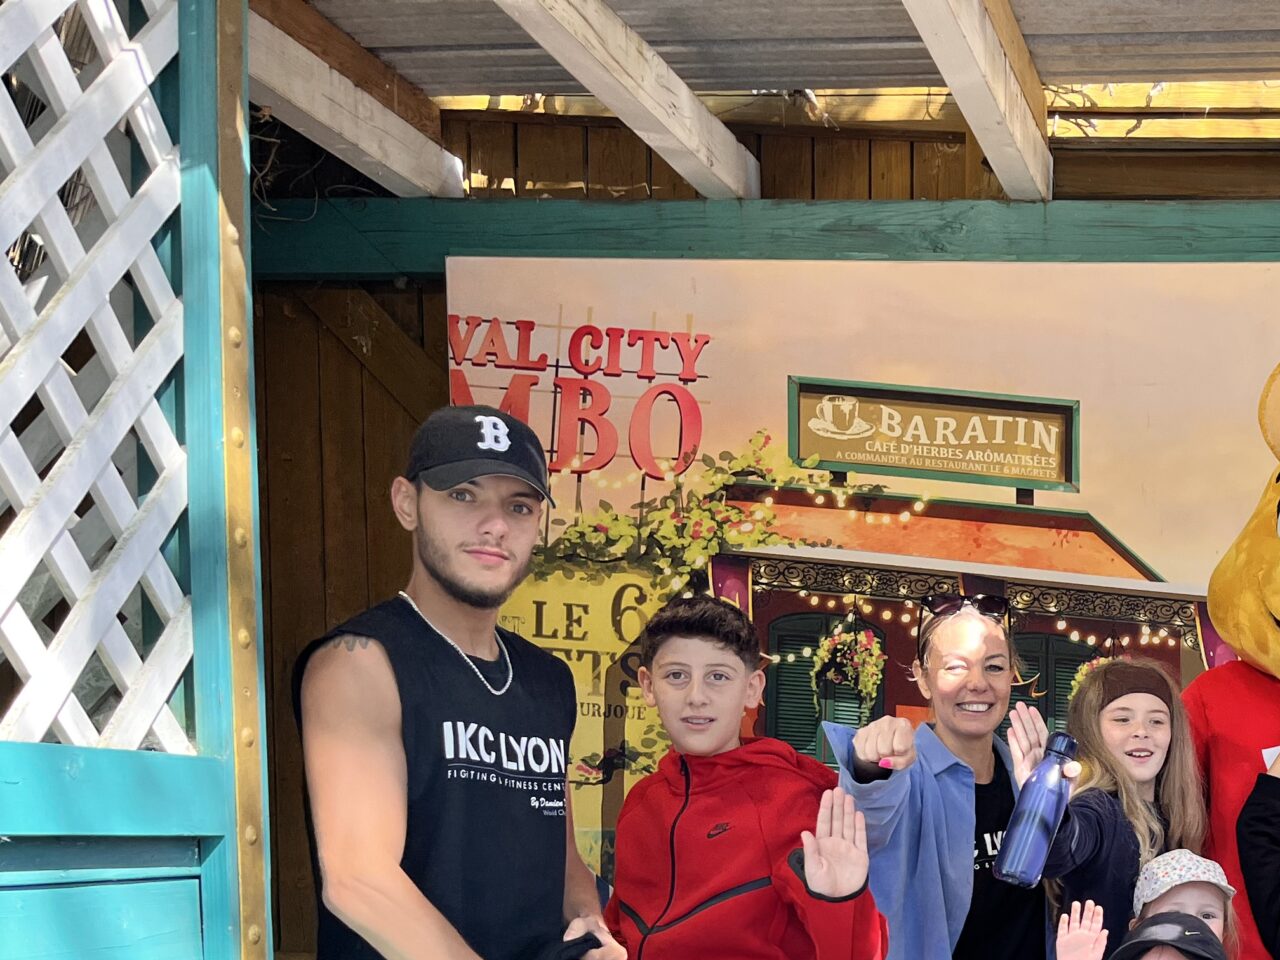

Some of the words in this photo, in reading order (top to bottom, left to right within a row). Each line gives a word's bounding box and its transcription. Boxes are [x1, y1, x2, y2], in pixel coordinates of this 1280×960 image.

[568, 325, 711, 382] CITY
[475, 415, 511, 451] B
[878, 404, 1059, 454] BARATIN
[845, 452, 907, 465] COMMANDER
[925, 458, 987, 472] RESTAURANT
[990, 464, 1001, 473] LE
[1003, 466, 1010, 474] 6
[1011, 466, 1058, 478] MAGRETS
[865, 440, 898, 453] CAFÉ
[900, 443, 963, 460] D'HERBES
[966, 449, 1056, 468] ARÔMATISÉES
[532, 601, 589, 641] LE
[611, 584, 650, 643] 6
[443, 721, 496, 763] IKC
[499, 732, 566, 774] LYON
[505, 778, 539, 790] FITNESS
[530, 797, 539, 809] By
